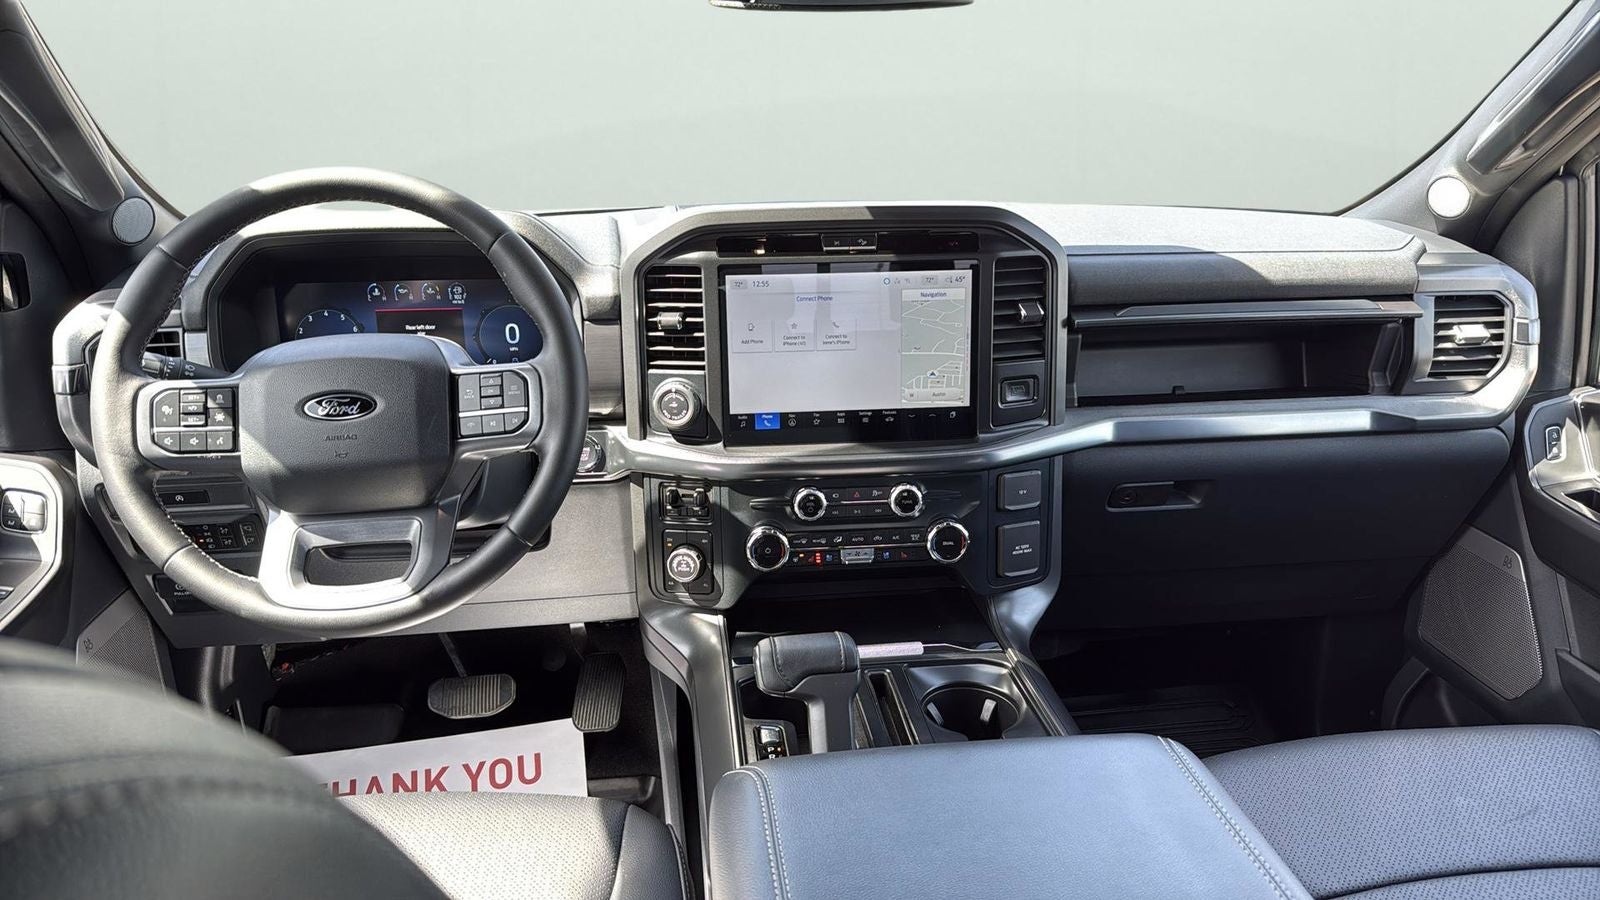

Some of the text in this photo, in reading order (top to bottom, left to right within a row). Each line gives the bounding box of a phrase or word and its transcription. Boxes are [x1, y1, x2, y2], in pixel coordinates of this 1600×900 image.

[752, 280, 770, 288] 12:55
[920, 291, 947, 299] Navigation
[340, 313, 345, 321] 5
[353, 325, 358, 333] 6
[505, 322, 520, 344] 0
[318, 398, 361, 416] Ford
[322, 752, 541, 796] HANK YOU
